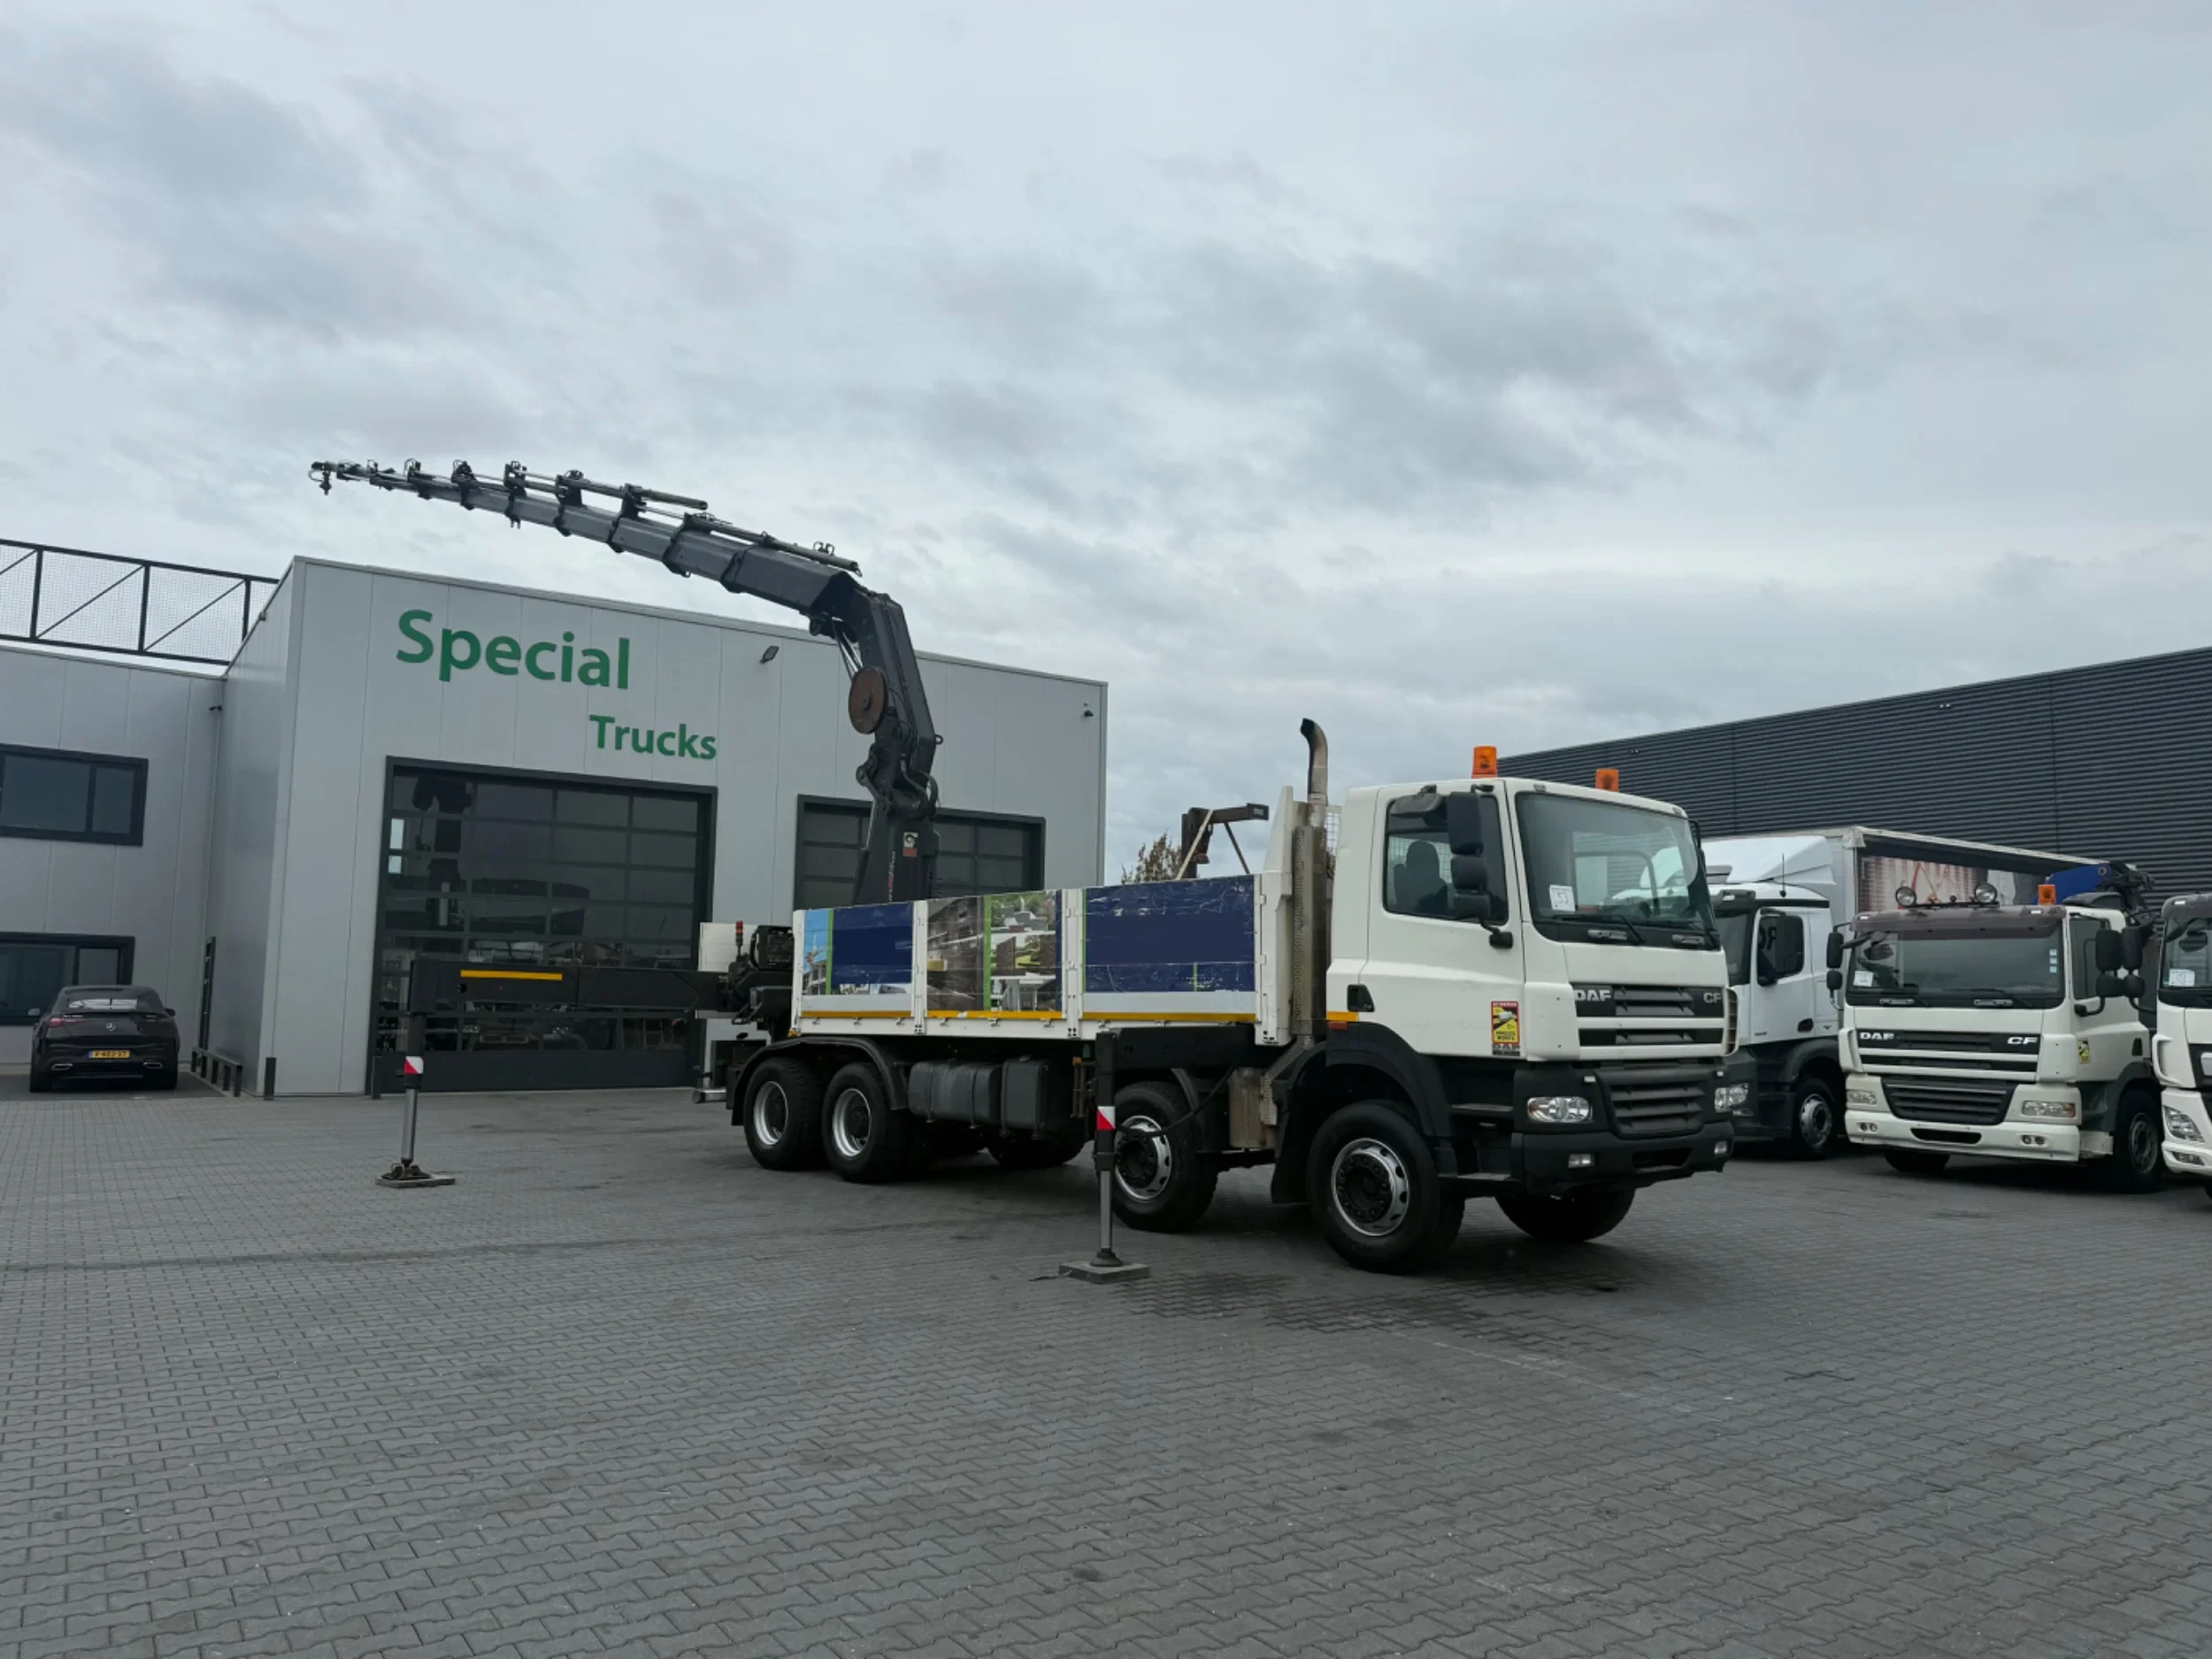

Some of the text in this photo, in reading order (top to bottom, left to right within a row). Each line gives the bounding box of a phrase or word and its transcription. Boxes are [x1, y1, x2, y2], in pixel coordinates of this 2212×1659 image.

[396, 609, 630, 689] Special
[589, 714, 717, 760] Trucks
[1574, 989, 1611, 1002] DAF
[1703, 992, 1722, 1003] CF
[1859, 1032, 1895, 1041] DAF
[2007, 1036, 2038, 1045] CF
